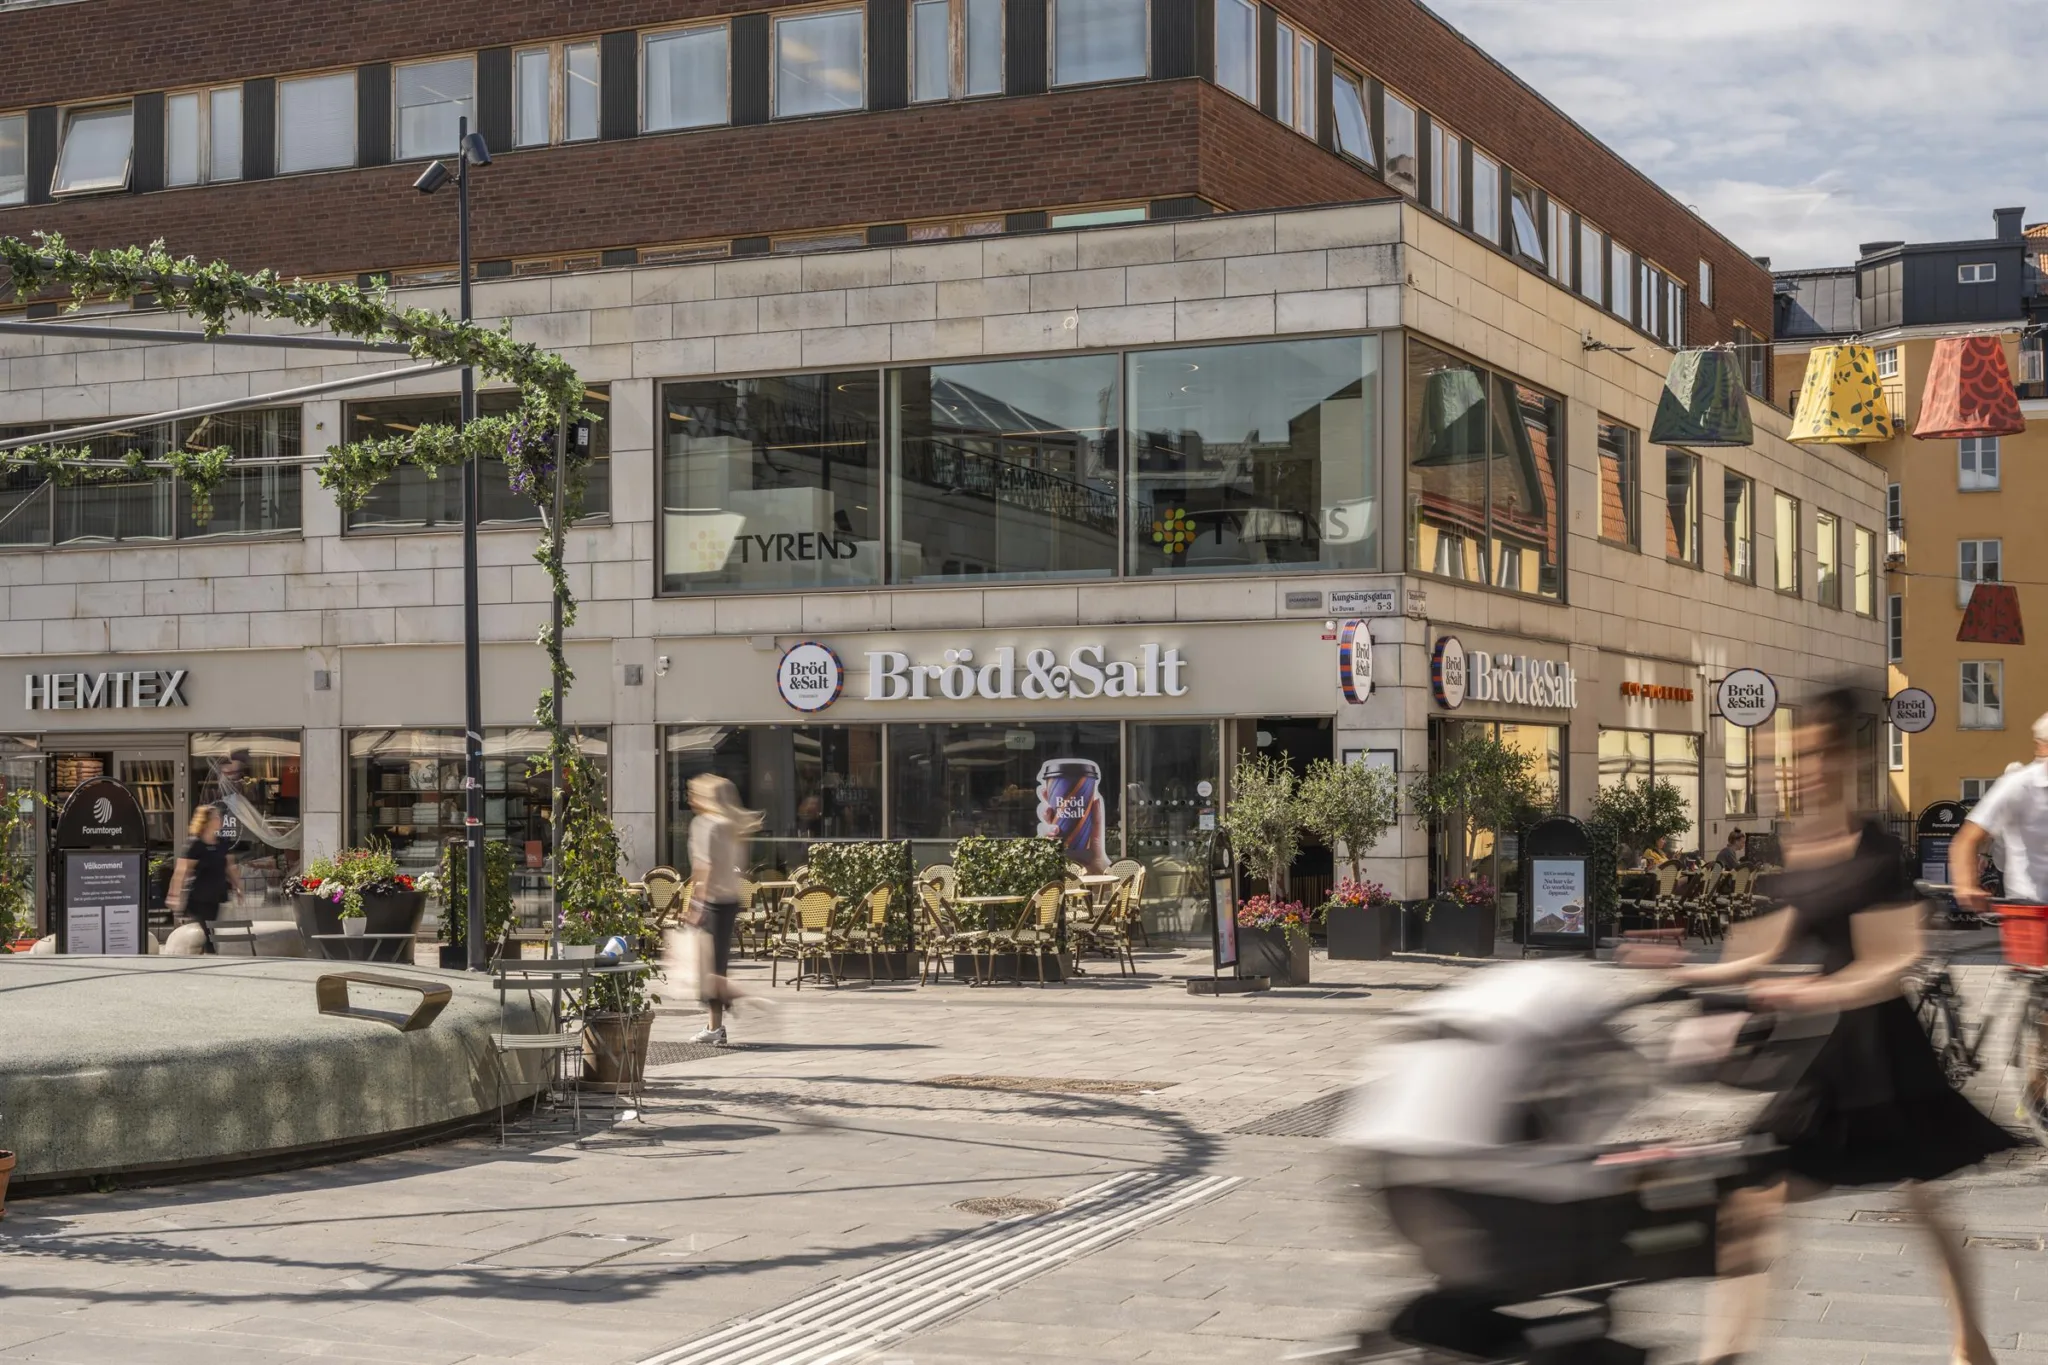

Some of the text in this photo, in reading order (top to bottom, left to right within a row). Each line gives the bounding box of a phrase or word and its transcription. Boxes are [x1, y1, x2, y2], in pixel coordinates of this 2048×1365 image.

[1206, 507, 1350, 549] TYNS
[734, 531, 858, 563] TYRENS
[1332, 592, 1392, 603] Kungsängsgatan
[1377, 601, 1392, 610] 5-3
[1356, 642, 1370, 660] Bröd
[789, 661, 828, 675] Bröd
[1355, 660, 1370, 677] &Salt
[1445, 656, 1462, 670] Bröd
[864, 643, 1189, 700] Bröd&Salt
[1445, 671, 1462, 686] &Salt
[789, 676, 830, 690] &Salt
[1473, 650, 1578, 709] Bröd&Salt
[25, 670, 189, 709] HEMTEX
[1727, 683, 1764, 696] Bröd
[1727, 696, 1766, 708] &Salt
[1897, 700, 1926, 709] Bröd
[1896, 709, 1927, 719] &Salt
[1055, 796, 1084, 807] Bröd
[1055, 807, 1086, 818] &Salt
[222, 814, 236, 828] ÅR
[82, 825, 123, 836] Forumtorget
[83, 861, 123, 870] Välkommen!
